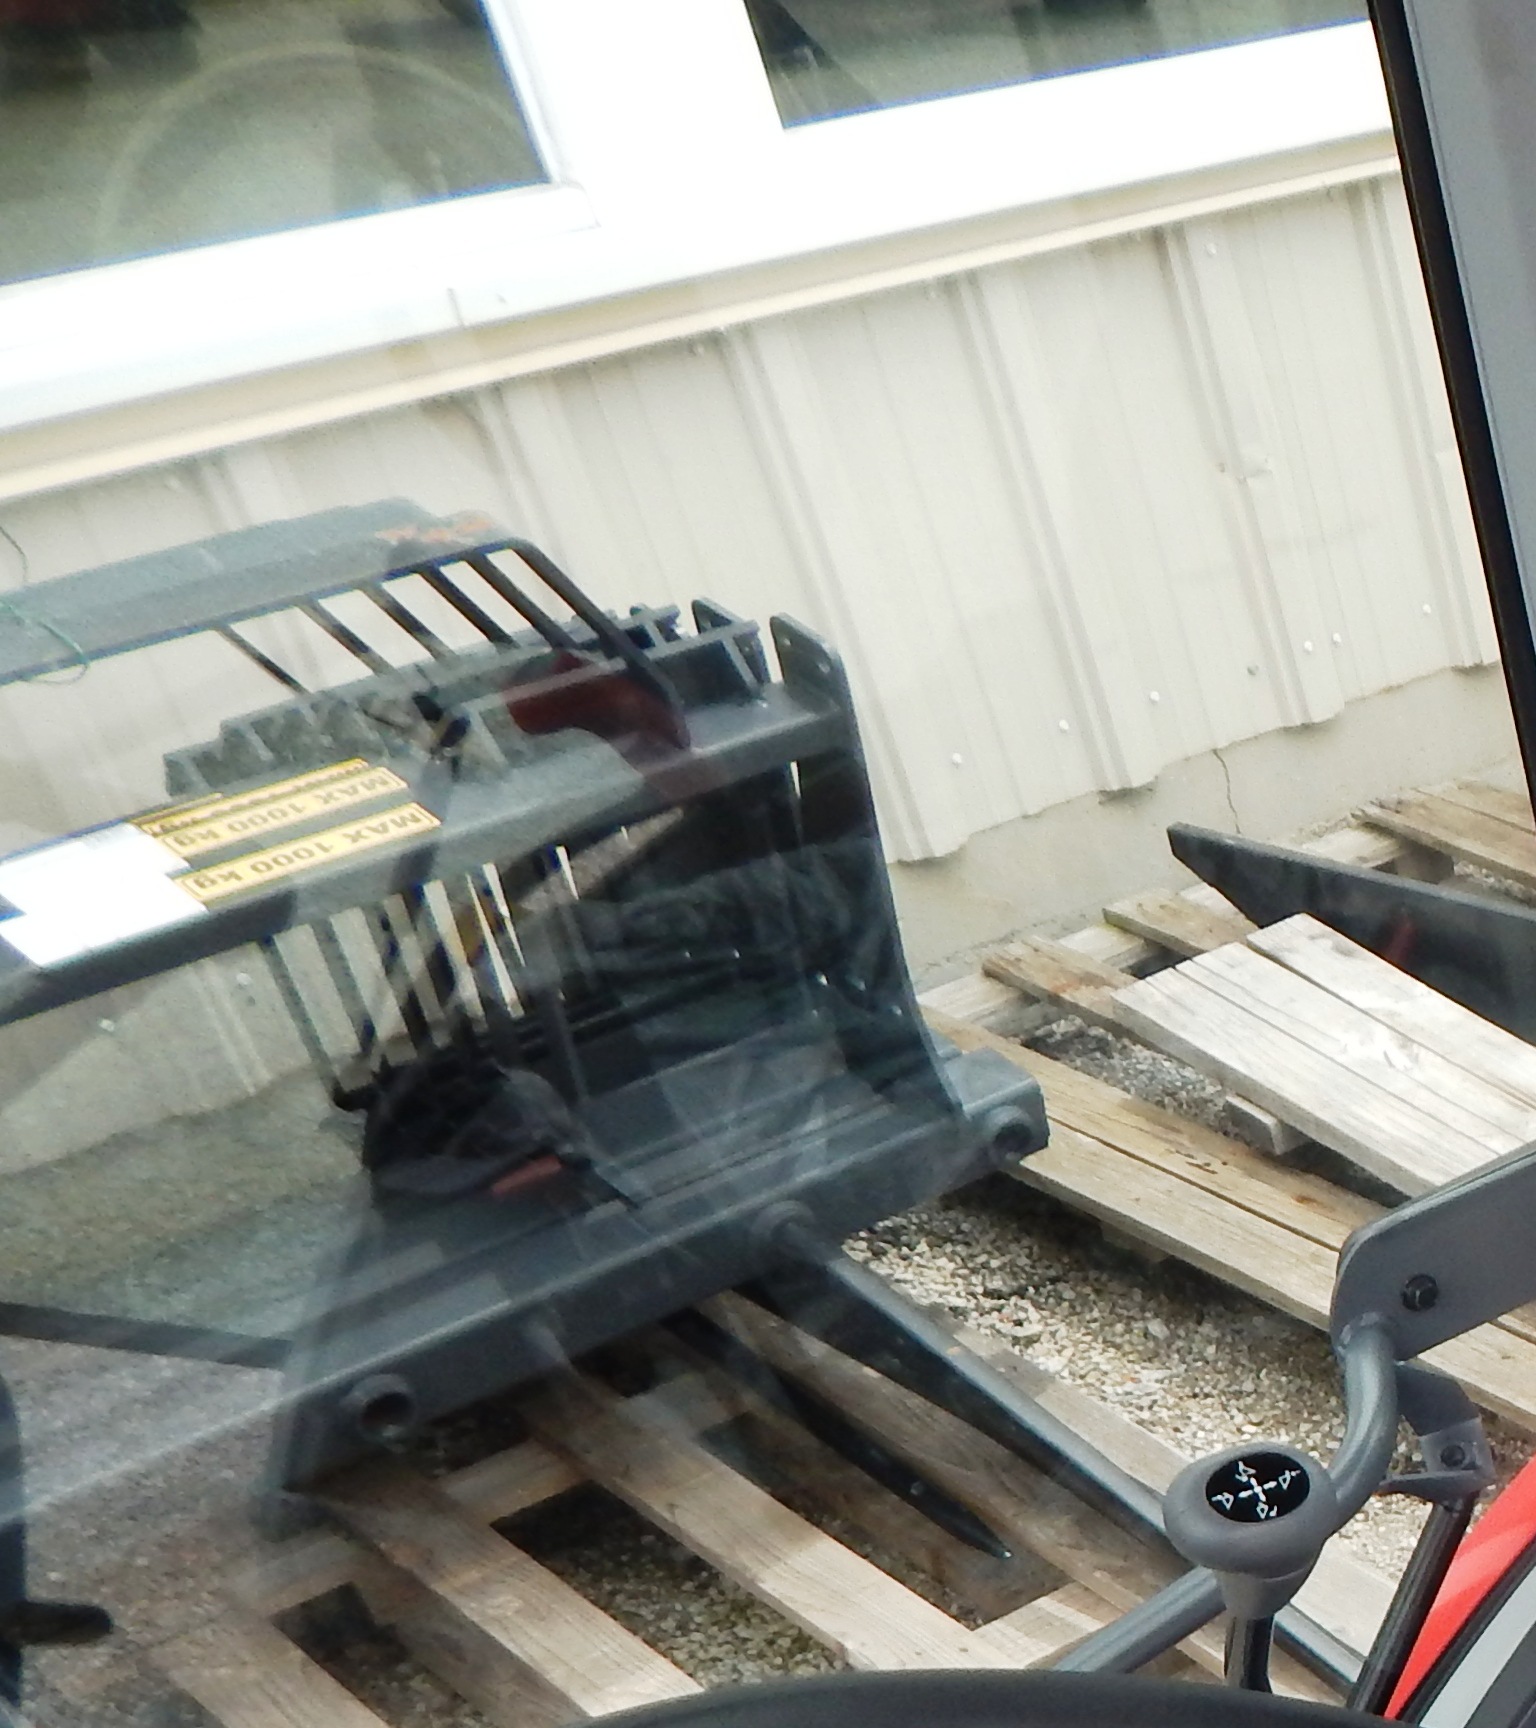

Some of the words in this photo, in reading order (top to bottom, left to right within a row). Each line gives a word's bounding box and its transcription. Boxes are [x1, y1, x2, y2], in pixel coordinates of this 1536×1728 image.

[320, 774, 390, 806] MAX
[227, 801, 305, 833] 1000
[342, 812, 422, 845] MAX
[250, 841, 334, 875] 1000
[192, 870, 243, 890] kg
